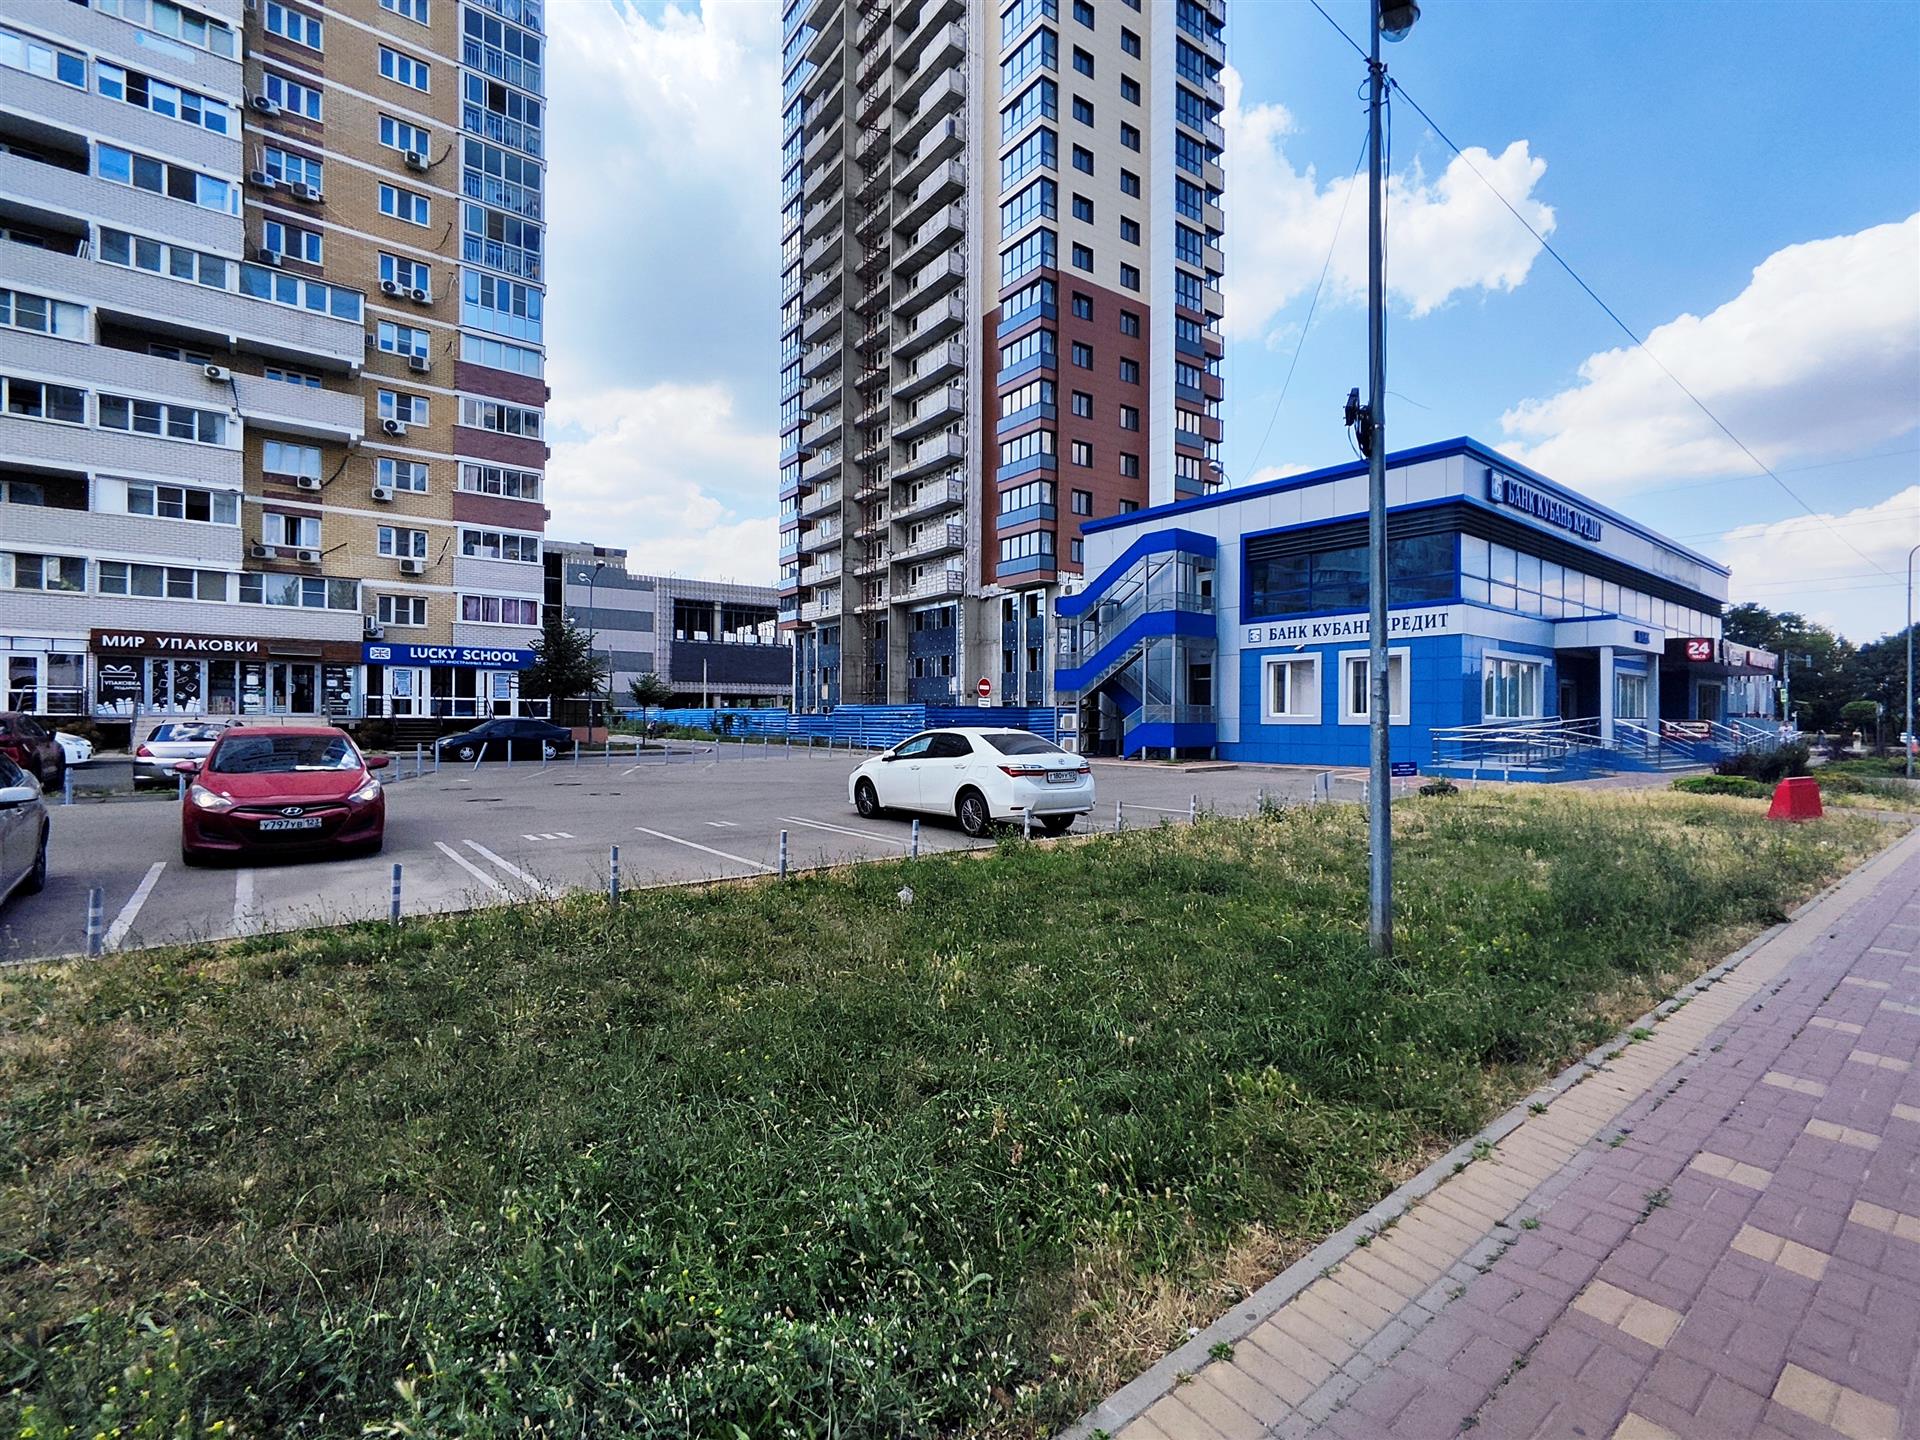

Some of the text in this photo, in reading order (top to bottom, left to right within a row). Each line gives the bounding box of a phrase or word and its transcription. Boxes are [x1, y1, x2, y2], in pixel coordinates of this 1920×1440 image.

[1508, 479, 1536, 514] БАНК
[1537, 493, 1573, 530] КУБАНЬ
[1269, 625, 1308, 641] БАНК
[1387, 612, 1449, 632] РЕДИТ
[102, 634, 258, 653] МИР УПАКОВКИ
[1688, 641, 1710, 654] 24
[410, 647, 519, 663] LUCKY SCHOOL
